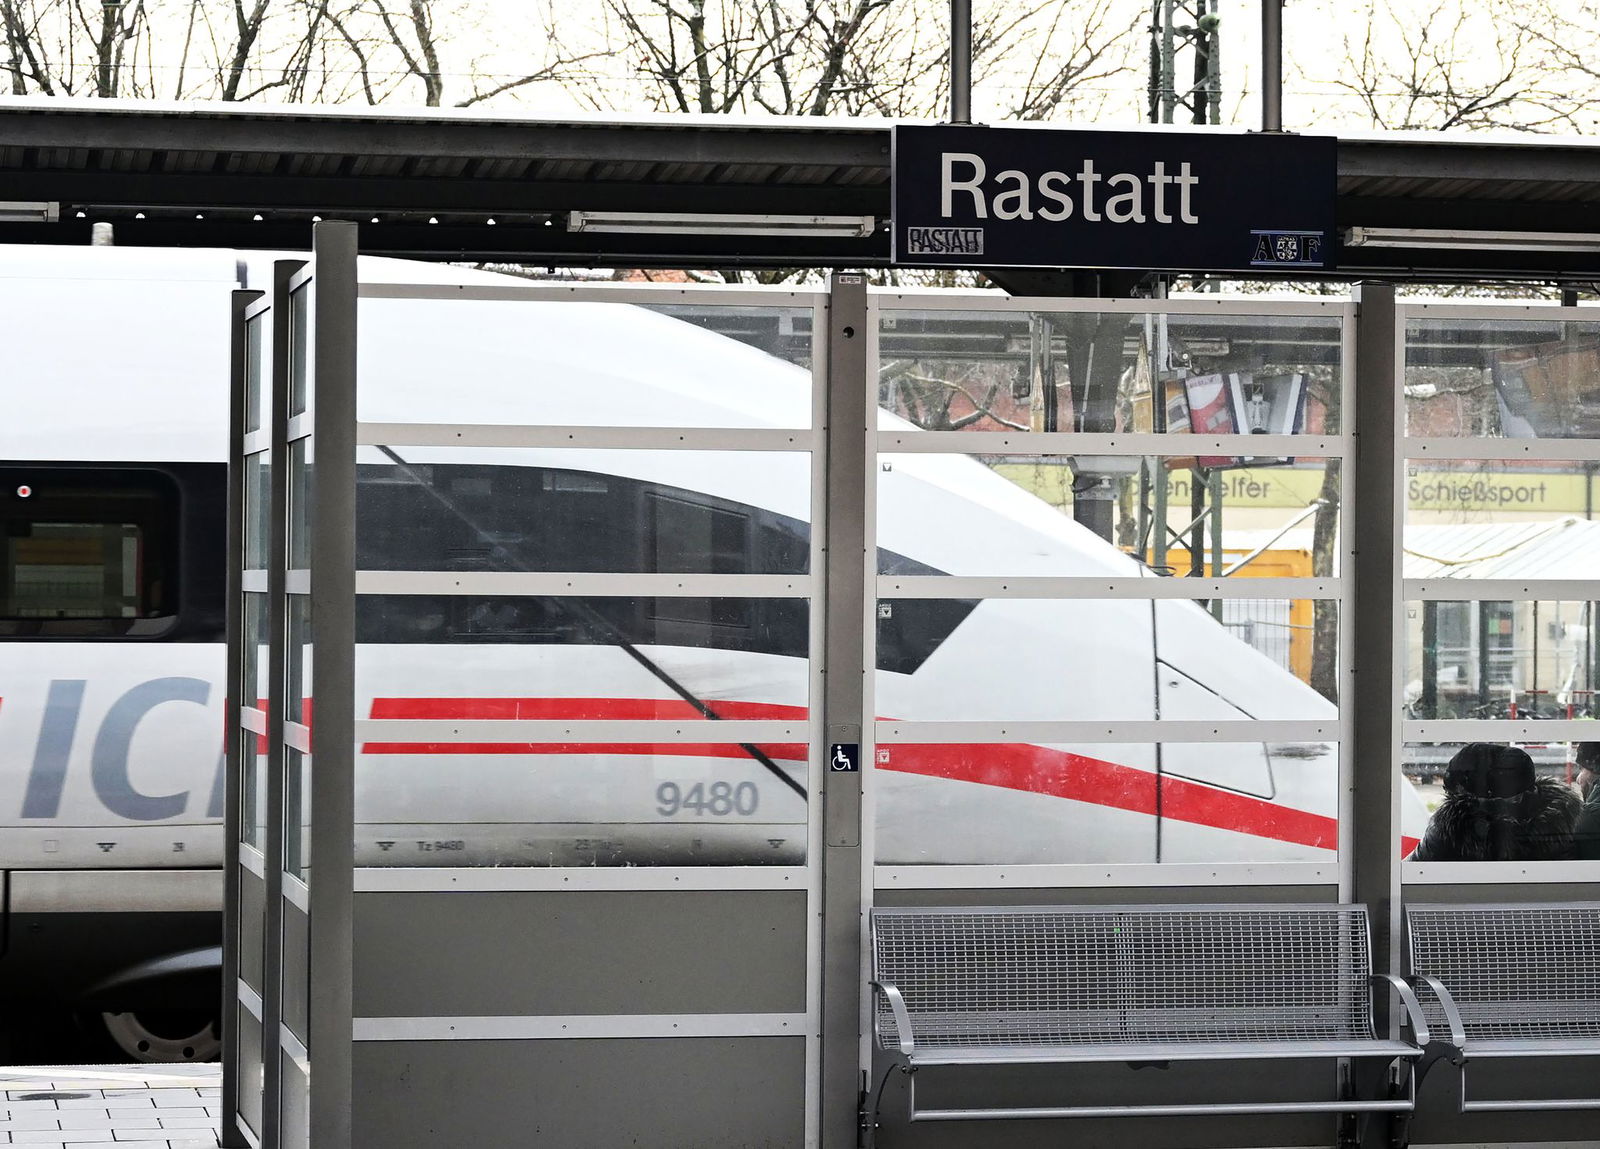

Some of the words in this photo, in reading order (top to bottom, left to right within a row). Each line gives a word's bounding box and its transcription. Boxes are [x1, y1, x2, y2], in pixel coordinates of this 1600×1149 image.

[941, 152, 1199, 224] Rastatt
[910, 229, 982, 253] RASTATT
[1408, 479, 1546, 507] Schießsport
[19, 676, 224, 822] IC
[656, 781, 759, 816] 9480
